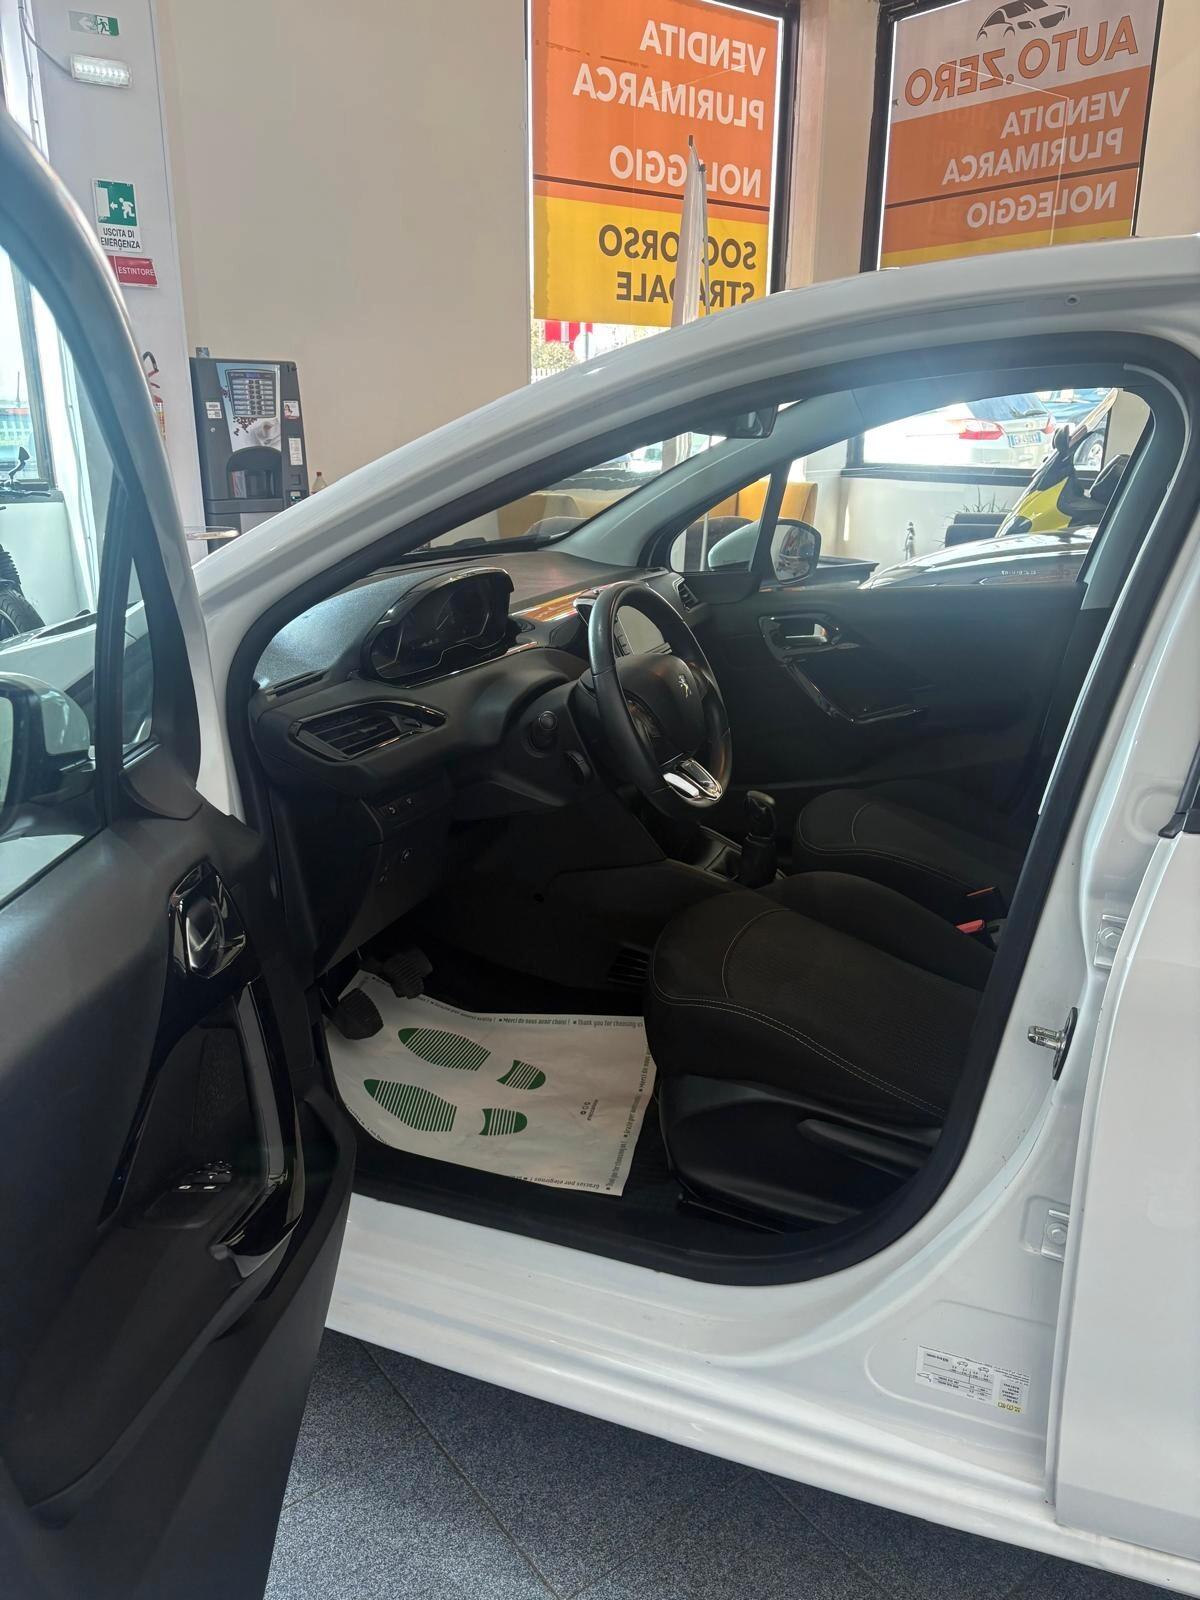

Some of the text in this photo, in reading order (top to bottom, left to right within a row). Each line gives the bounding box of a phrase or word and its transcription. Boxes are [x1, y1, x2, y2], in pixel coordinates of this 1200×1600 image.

[102, 227, 135, 238] USCITA DI
[100, 236, 141, 249] EMERGENZA
[118, 266, 155, 277] ESTINTORE
[576, 1181, 600, 1189] Gracias
